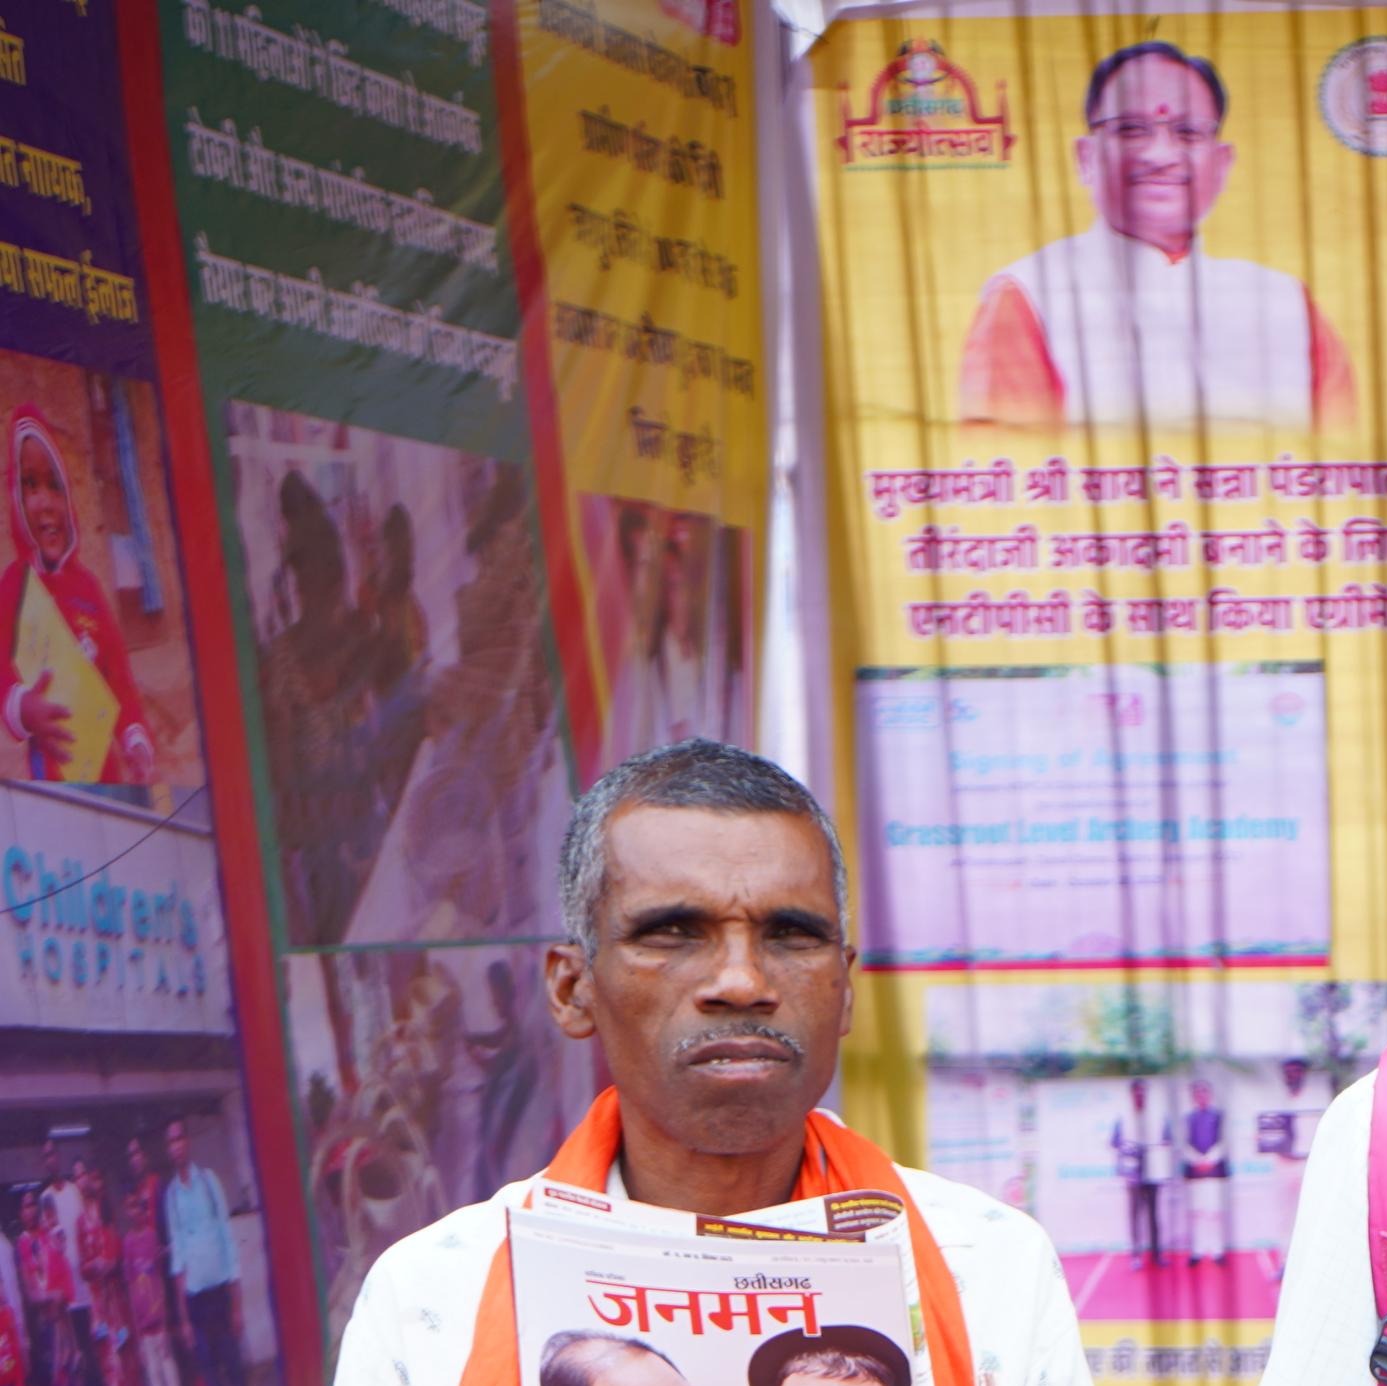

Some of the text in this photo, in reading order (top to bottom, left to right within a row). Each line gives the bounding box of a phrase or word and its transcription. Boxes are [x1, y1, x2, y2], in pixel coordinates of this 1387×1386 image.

[869, 459, 1014, 520] मुख्यमंत्री
[1026, 459, 1068, 502] श्री
[1080, 464, 1148, 500] साय
[1155, 456, 1182, 500] ने
[904, 525, 1038, 571] तीरंदाजी
[1050, 523, 1189, 570] अकादमी
[1202, 522, 1287, 566] बनाने
[1296, 520, 1328, 564] के
[904, 593, 1072, 638] एनटीपीसी
[1082, 590, 1115, 635] के
[1127, 598, 1197, 633] साथ
[1207, 588, 1292, 632] किया
[586, 1281, 822, 1336] जनमन
